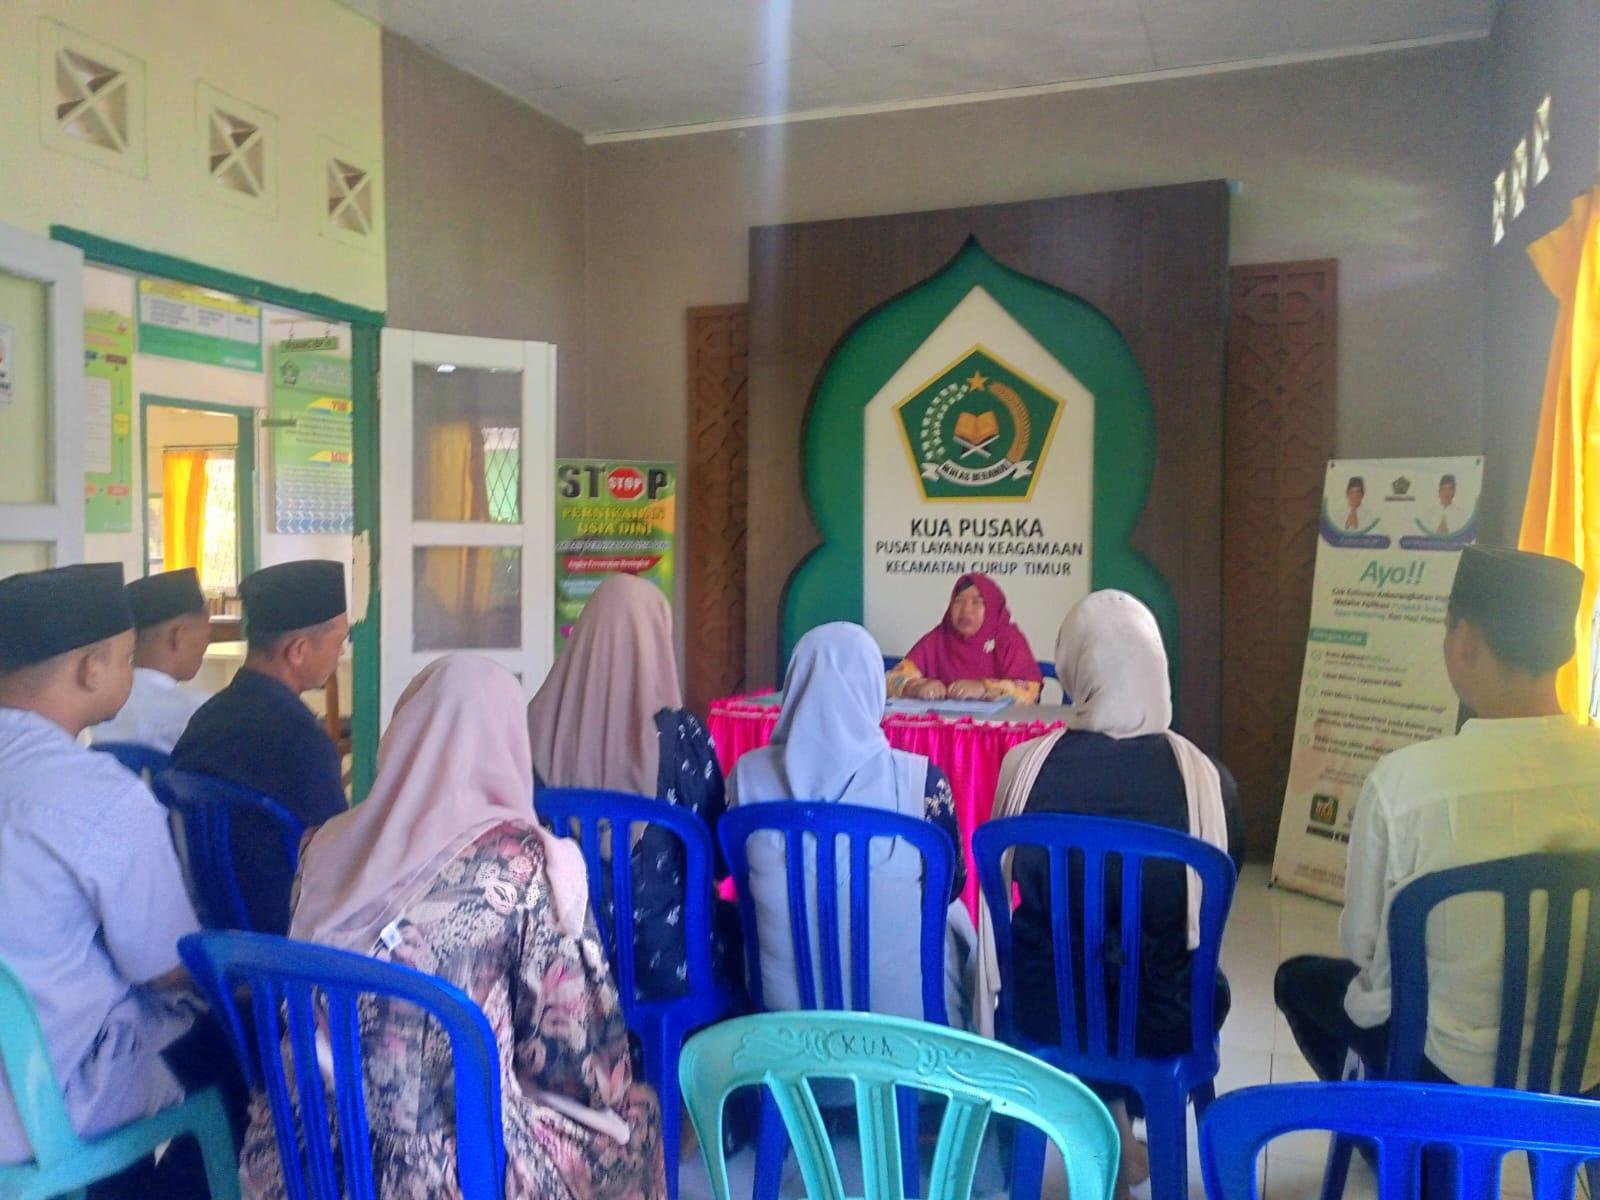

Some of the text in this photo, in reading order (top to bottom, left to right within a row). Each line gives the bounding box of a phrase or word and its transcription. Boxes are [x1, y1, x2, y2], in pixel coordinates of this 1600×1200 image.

[577, 521, 652, 535] USIA DINI
[911, 518, 1044, 537] KUA PUSAKA
[876, 541, 1083, 556] PUSAT LAYANAN KEAGAMAAN
[886, 560, 1071, 576] KECAMATAN CURUP TIMUR
[1360, 560, 1426, 587] Ayo!!
[842, 1034, 893, 1057] KUA
